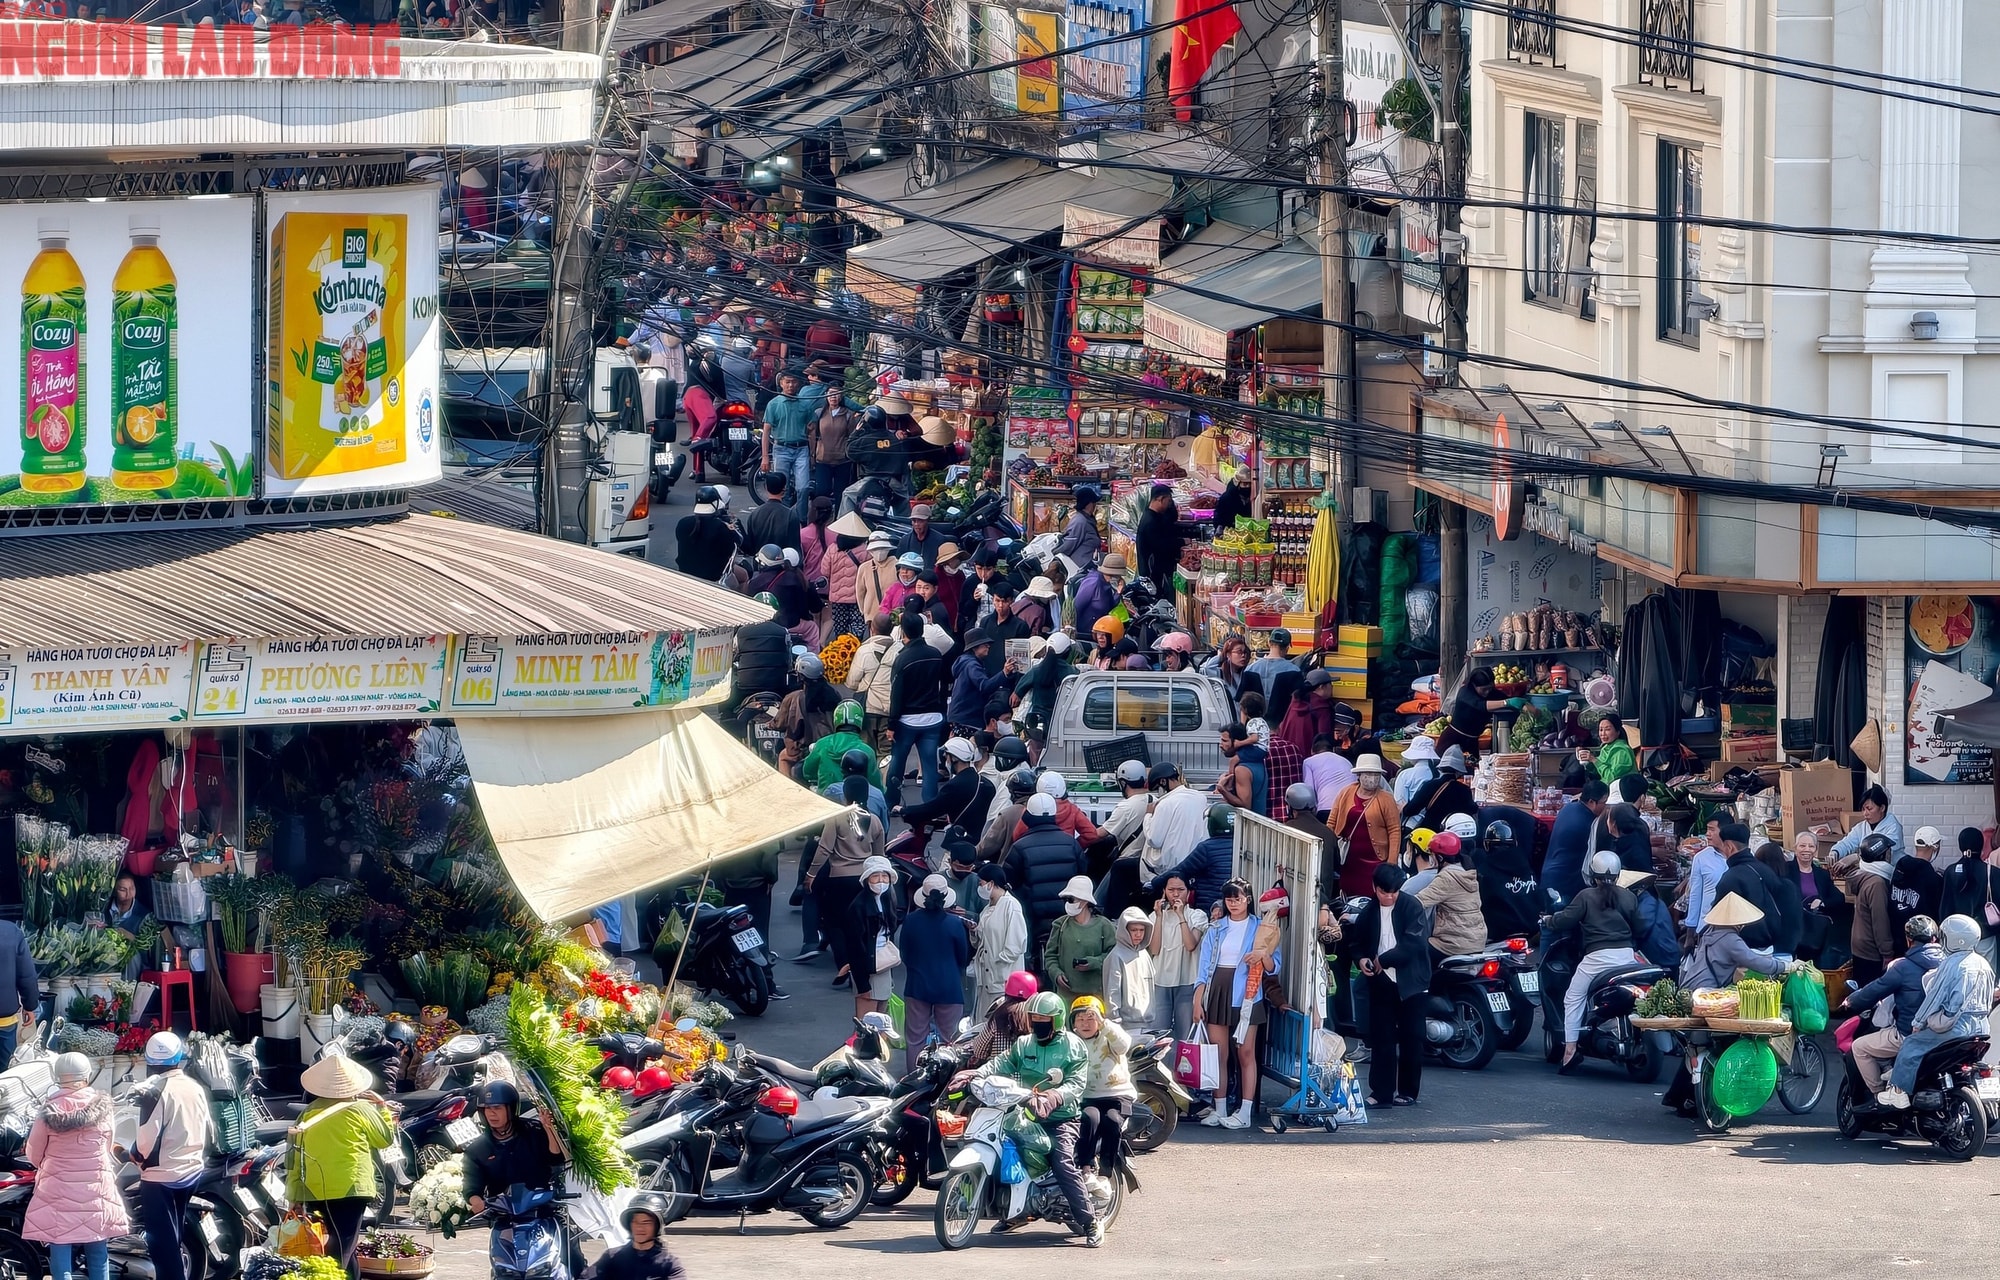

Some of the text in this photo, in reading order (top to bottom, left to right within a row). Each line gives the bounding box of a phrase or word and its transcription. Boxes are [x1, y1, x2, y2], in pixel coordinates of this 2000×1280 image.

[346, 236, 366, 253] BIO
[34, 325, 72, 345] Cozy
[124, 323, 163, 344] Cozy
[316, 356, 331, 369] 250
[268, 635, 426, 654] HÀNG HOA TƯƠI CHỢ ĐÀ LẠT
[546, 632, 568, 646] HOA
[27, 645, 179, 663] HÀNG HOA TƯƠI CHỢ ĐÀ LẠT
[260, 656, 428, 692] PHƯƠNG LIÊN
[514, 645, 640, 684] MINH TÂM
[31, 662, 170, 691] THANH VÂN
[230, 673, 240, 682] SỐ
[53, 692, 85, 705] (Kim
[461, 677, 493, 701] 06
[203, 687, 239, 711] 24
